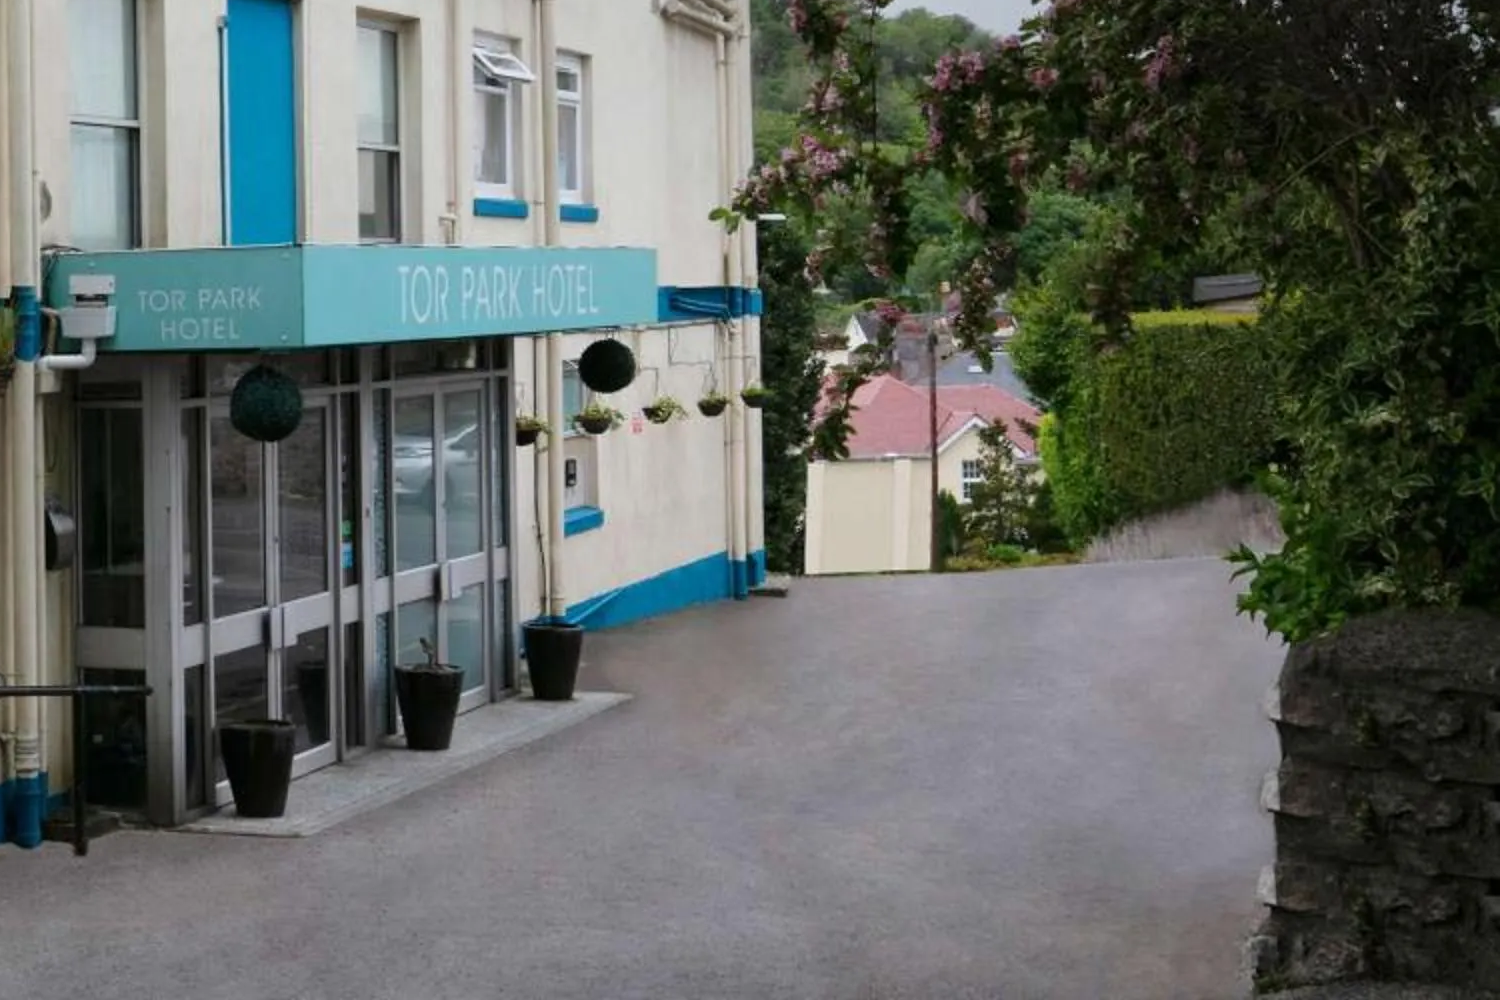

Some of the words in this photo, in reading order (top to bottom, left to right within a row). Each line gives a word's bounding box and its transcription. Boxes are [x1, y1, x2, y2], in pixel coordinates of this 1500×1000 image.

[137, 289, 187, 314] TOR
[198, 286, 261, 310] PARK
[397, 265, 449, 324] TOR
[461, 265, 524, 320] PARK
[533, 263, 599, 317] HOTEL
[160, 317, 240, 341] HOTEL
